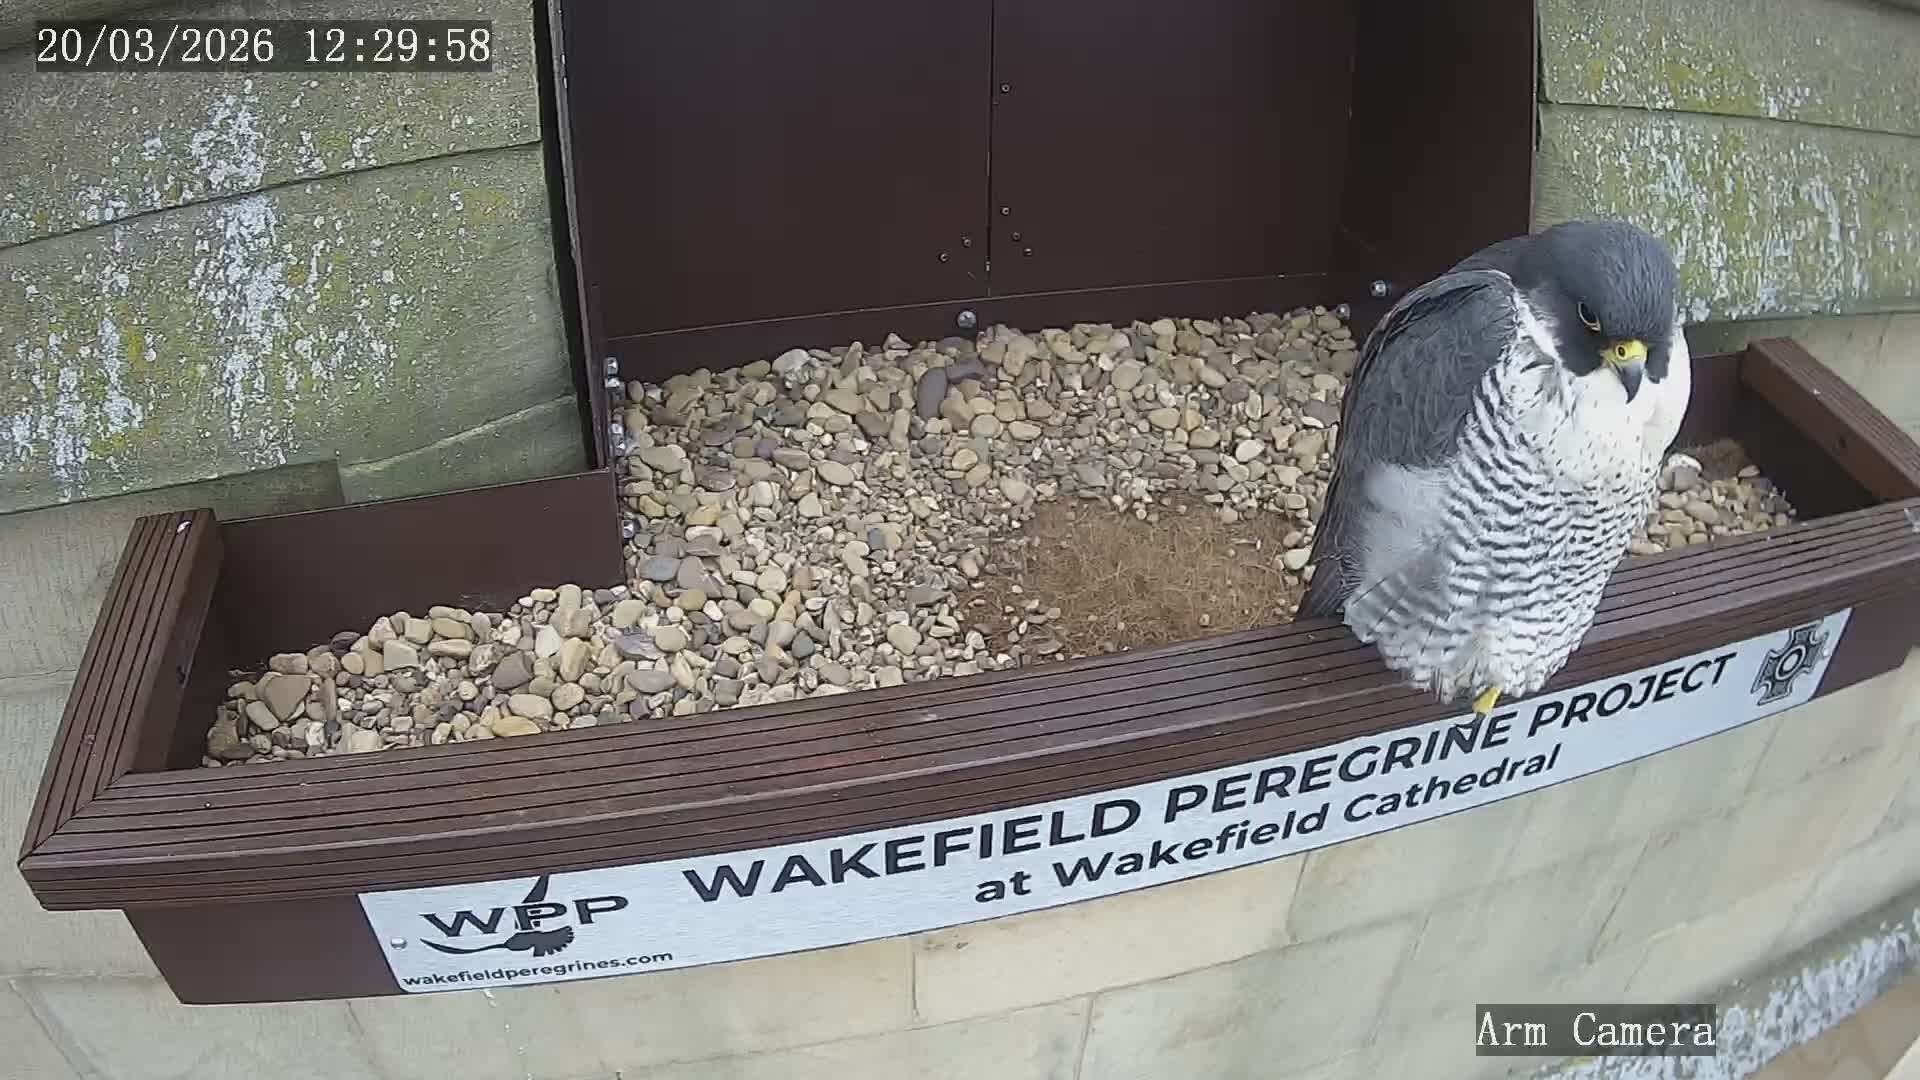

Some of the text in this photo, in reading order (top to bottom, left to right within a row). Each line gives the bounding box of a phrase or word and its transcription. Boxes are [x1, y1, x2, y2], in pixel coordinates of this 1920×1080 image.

[681, 652, 1738, 902] WAKEFIELD PEREGRINE PROJECT
[975, 743, 1561, 903] at Wakefield Cathedral
[420, 895, 629, 937] WPP
[402, 951, 673, 986] wakefieldperegrines.com
